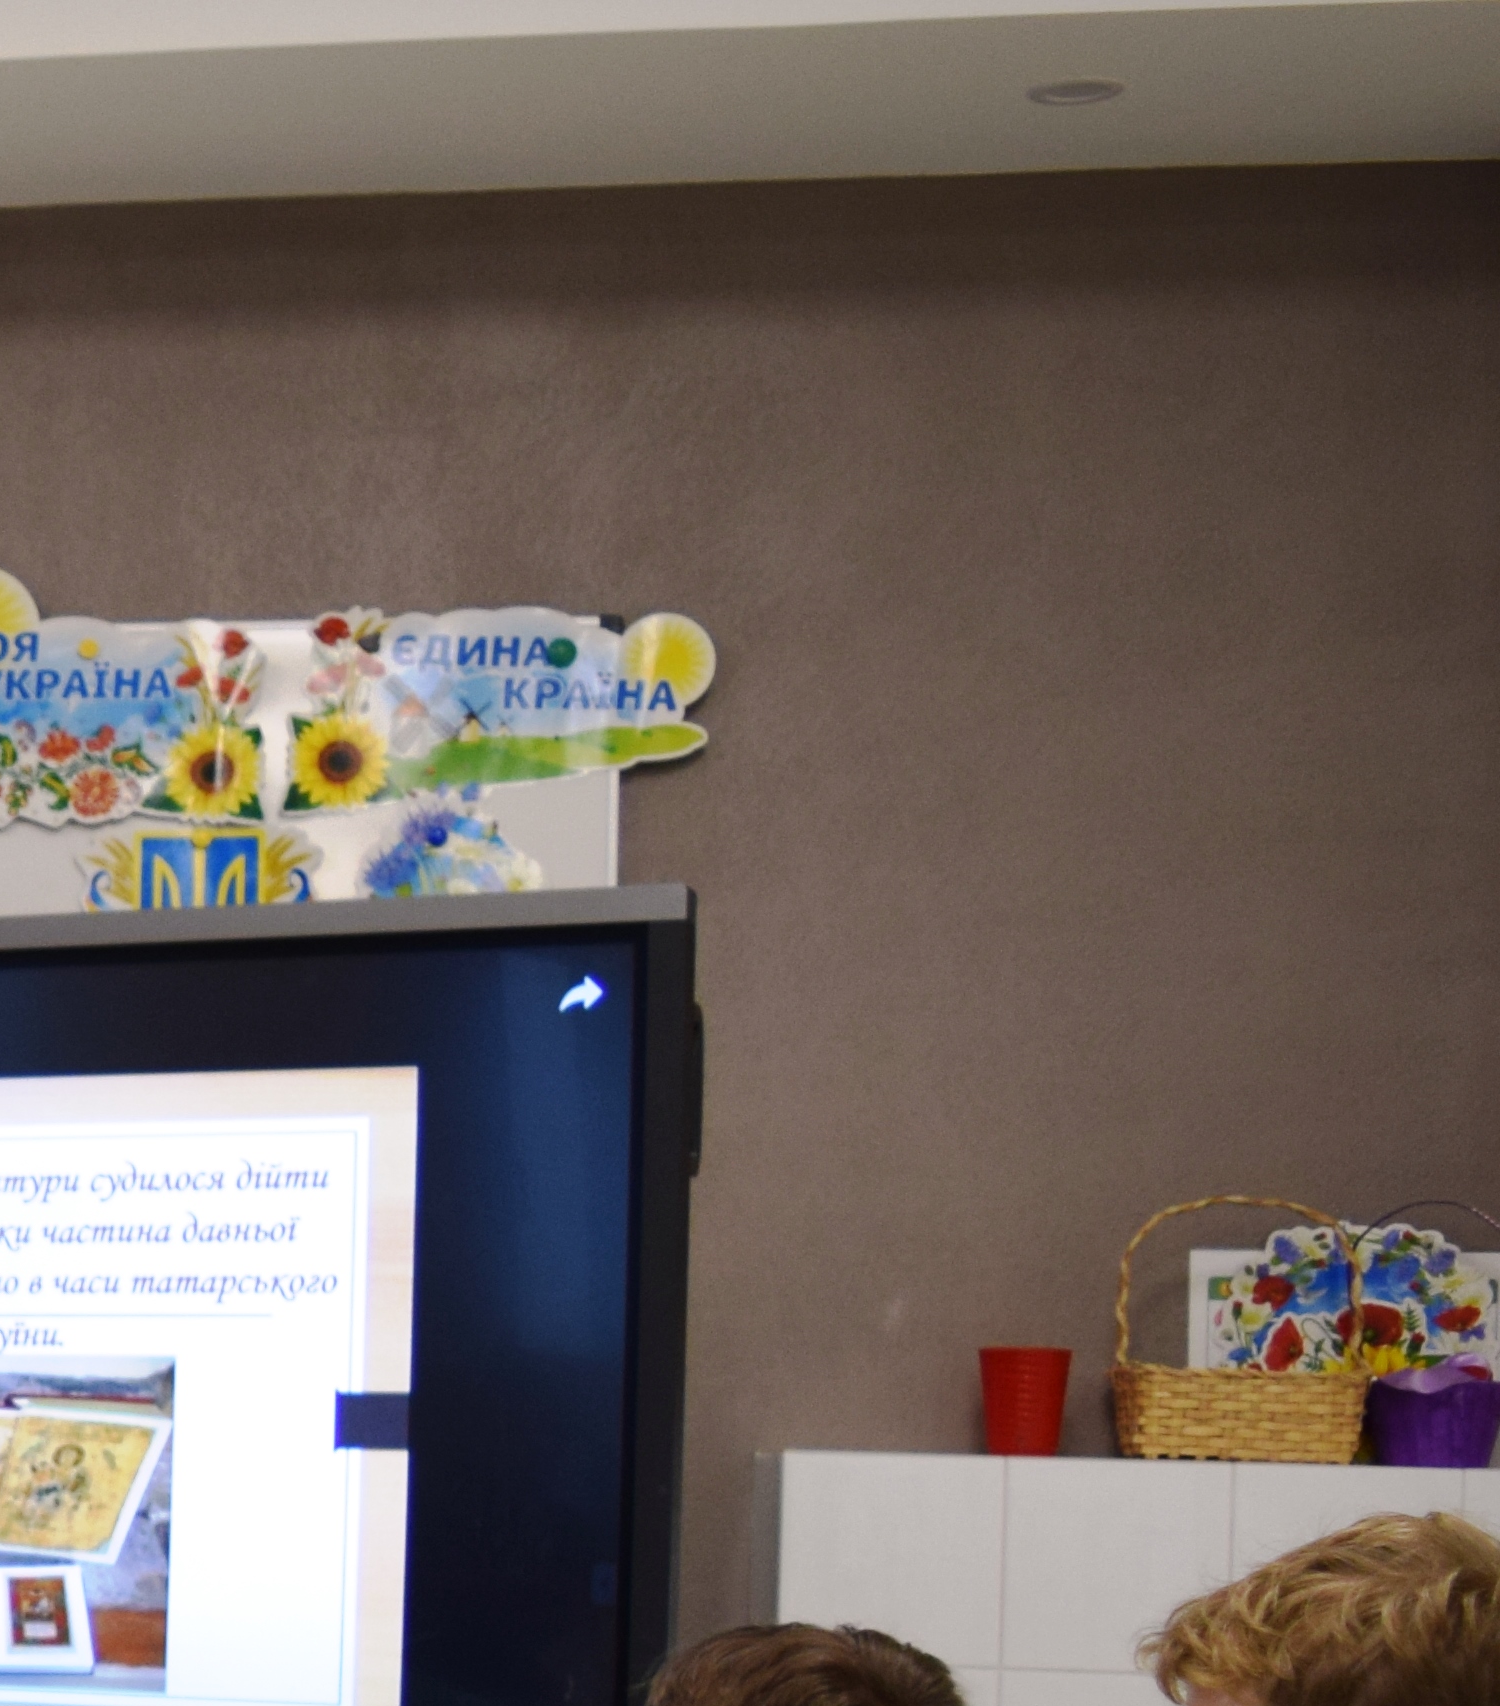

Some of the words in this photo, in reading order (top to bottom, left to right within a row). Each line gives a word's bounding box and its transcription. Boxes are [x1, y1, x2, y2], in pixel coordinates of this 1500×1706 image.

[391, 634, 552, 671] ЄДИНА
[503, 671, 677, 711] КРАЇНА
[89, 1160, 225, 1203] судилося
[235, 1157, 330, 1194] дійти
[43, 1220, 171, 1245] частина
[181, 1211, 300, 1245] давньої
[28, 1276, 44, 1296] в
[53, 1271, 120, 1296] часи
[130, 1270, 339, 1303] татарського
